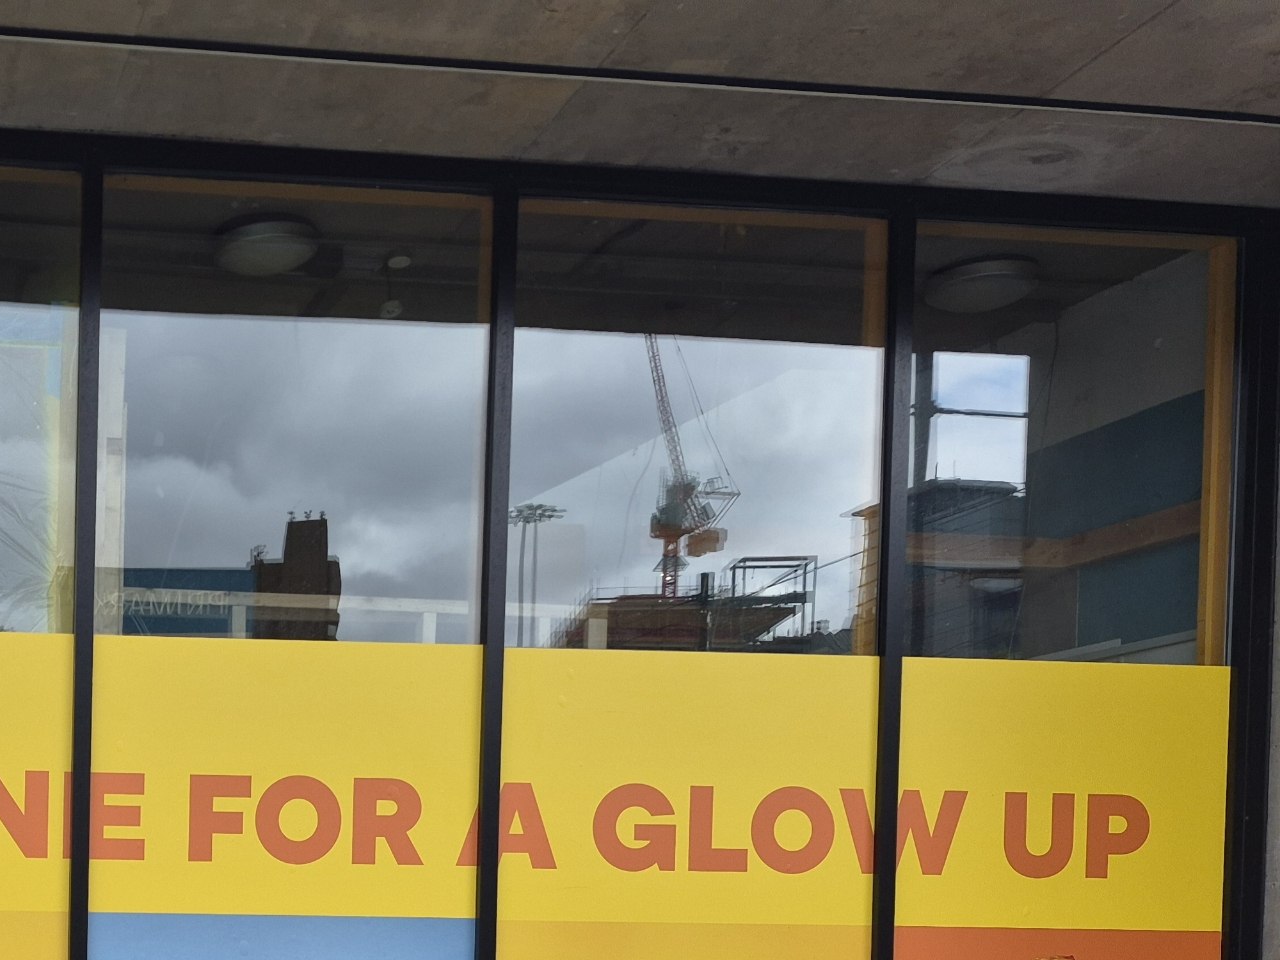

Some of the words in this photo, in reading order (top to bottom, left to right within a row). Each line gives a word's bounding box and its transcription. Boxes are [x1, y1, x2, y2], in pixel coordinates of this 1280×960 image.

[188, 774, 424, 865] FOR
[456, 782, 557, 869] A
[592, 782, 969, 876] GLOW
[1003, 791, 1150, 878] UP
